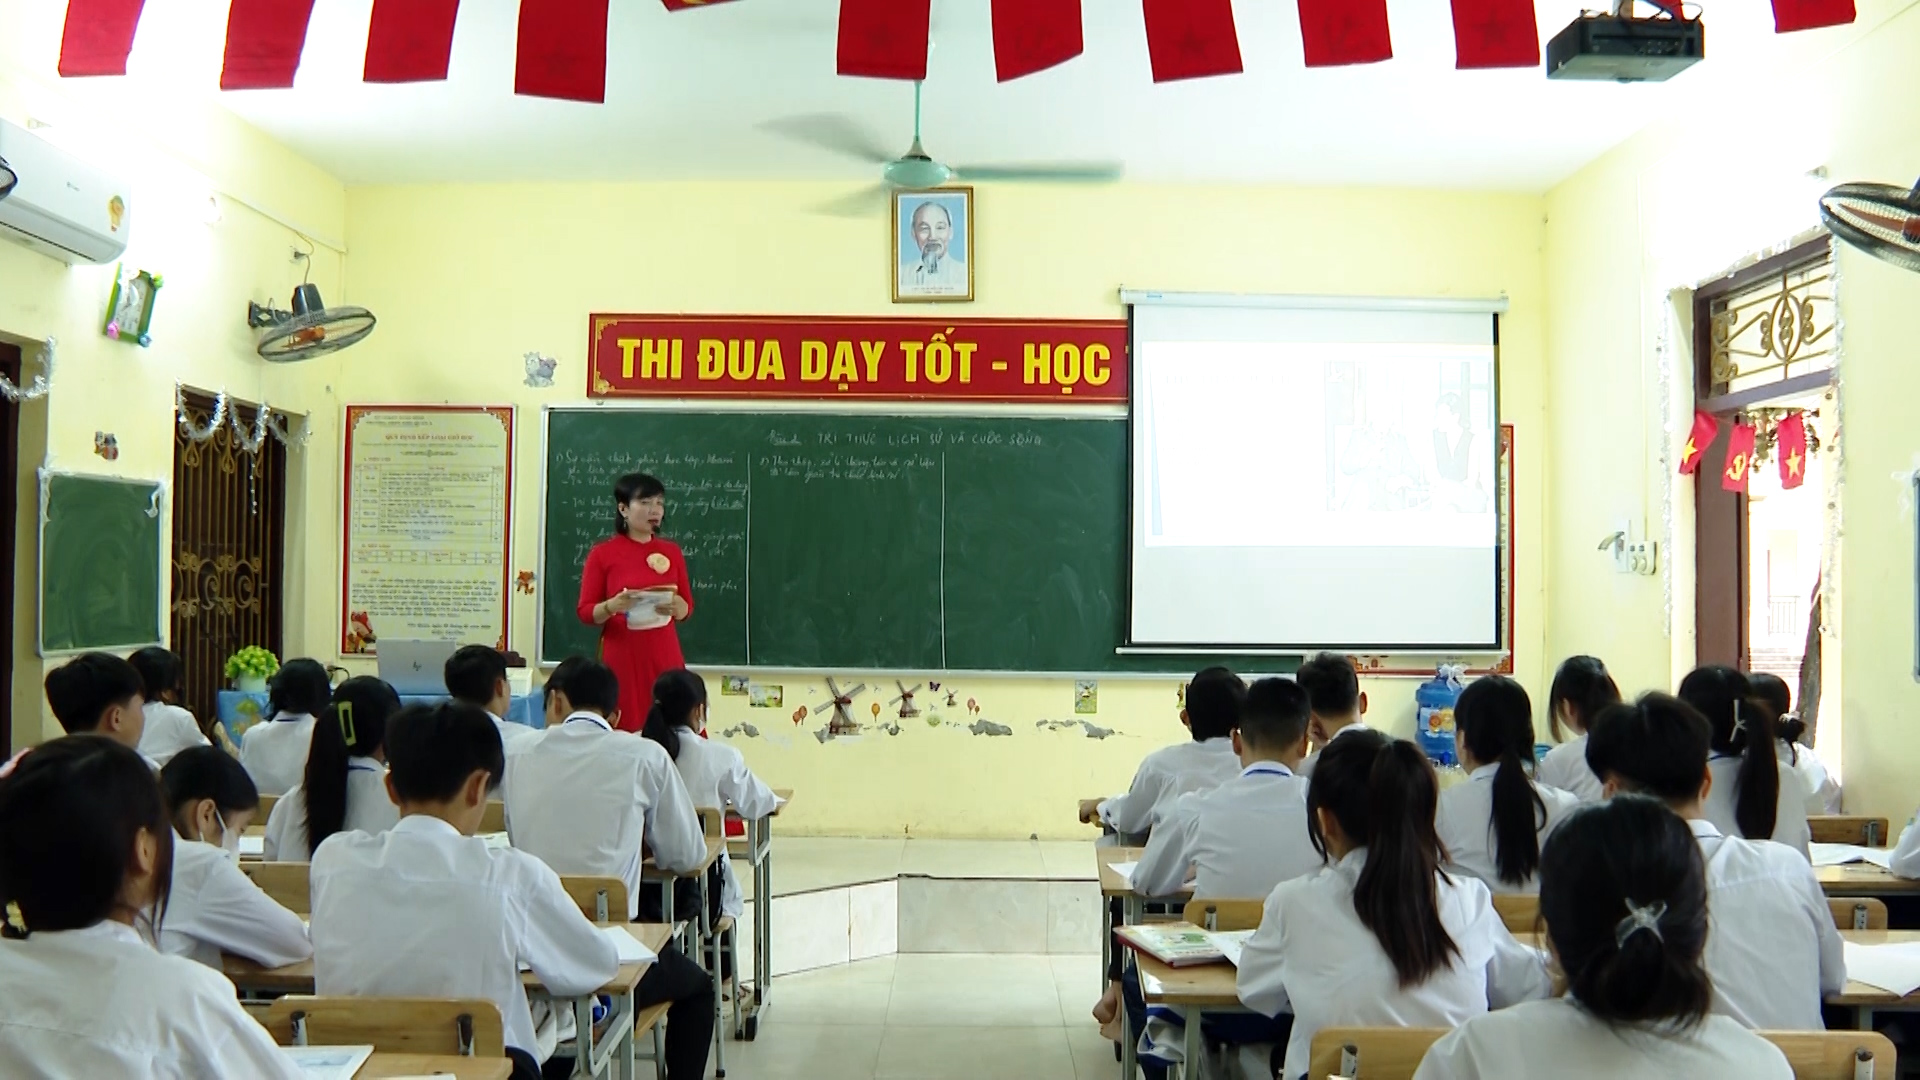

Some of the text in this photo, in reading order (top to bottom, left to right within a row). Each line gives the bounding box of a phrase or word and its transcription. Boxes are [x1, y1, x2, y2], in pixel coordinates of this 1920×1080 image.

[617, 338, 682, 379] THI
[697, 339, 785, 381] ĐUA
[800, 340, 886, 391] DẠY
[899, 327, 978, 384] TỐT
[1023, 343, 1111, 394] HỌC
